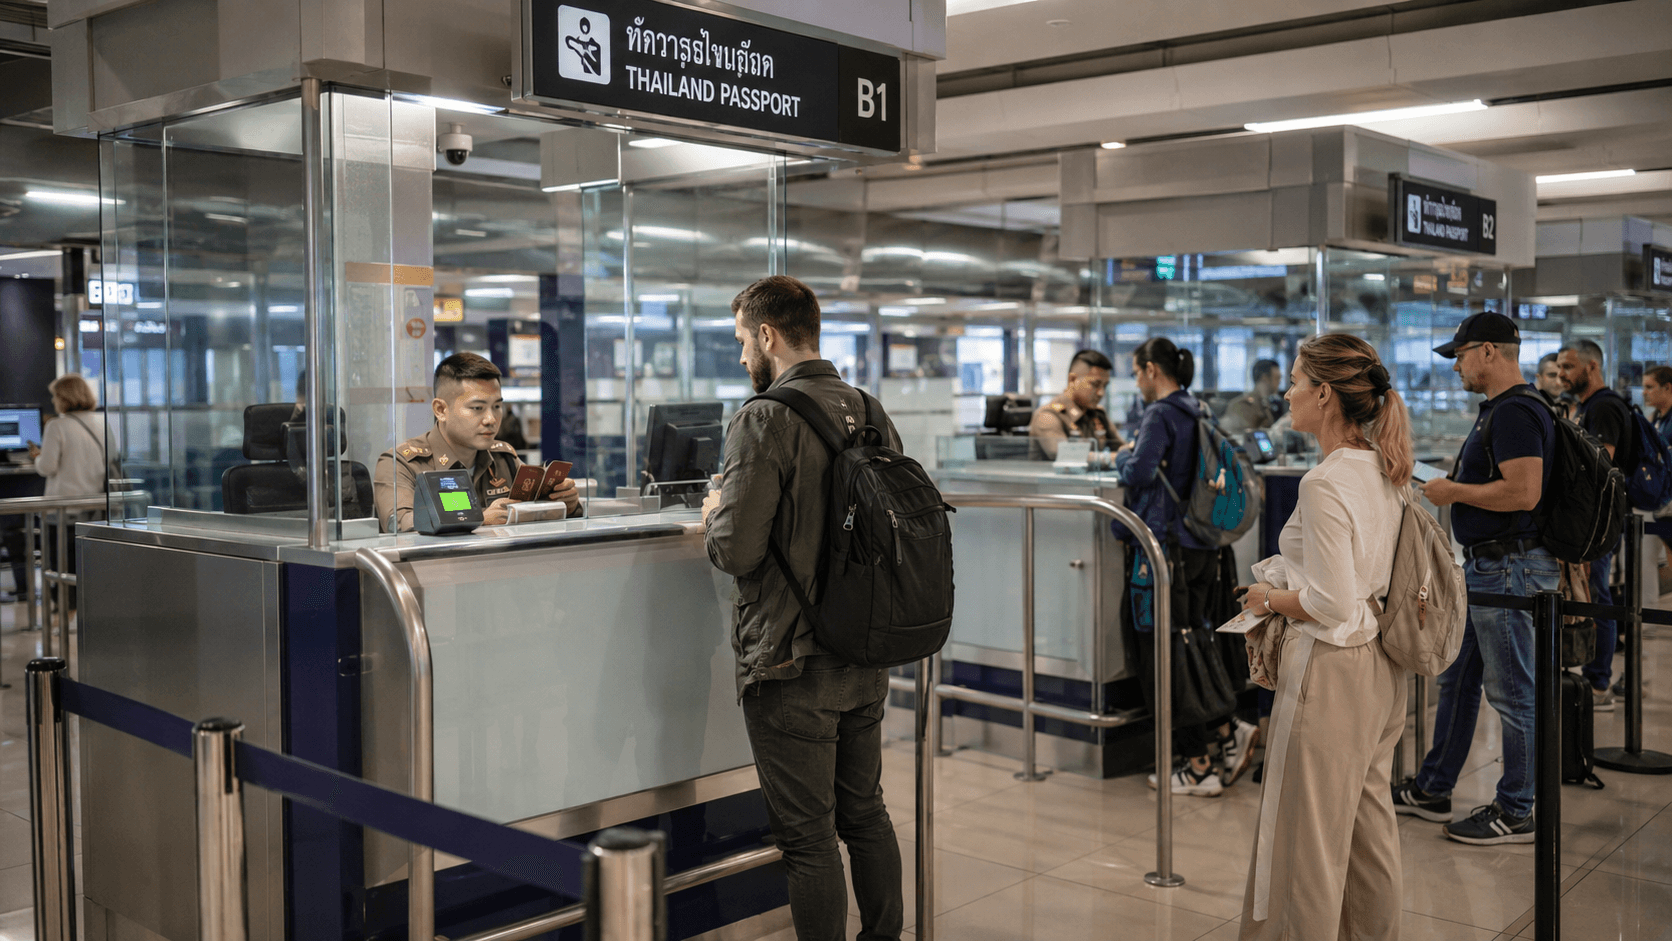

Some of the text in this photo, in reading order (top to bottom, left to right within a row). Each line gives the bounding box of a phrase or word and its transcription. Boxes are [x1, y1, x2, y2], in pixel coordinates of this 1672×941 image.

[625, 65, 801, 118] THAILAND PASSPORT
[857, 77, 888, 122] B1
[1482, 213, 1494, 240] B2
